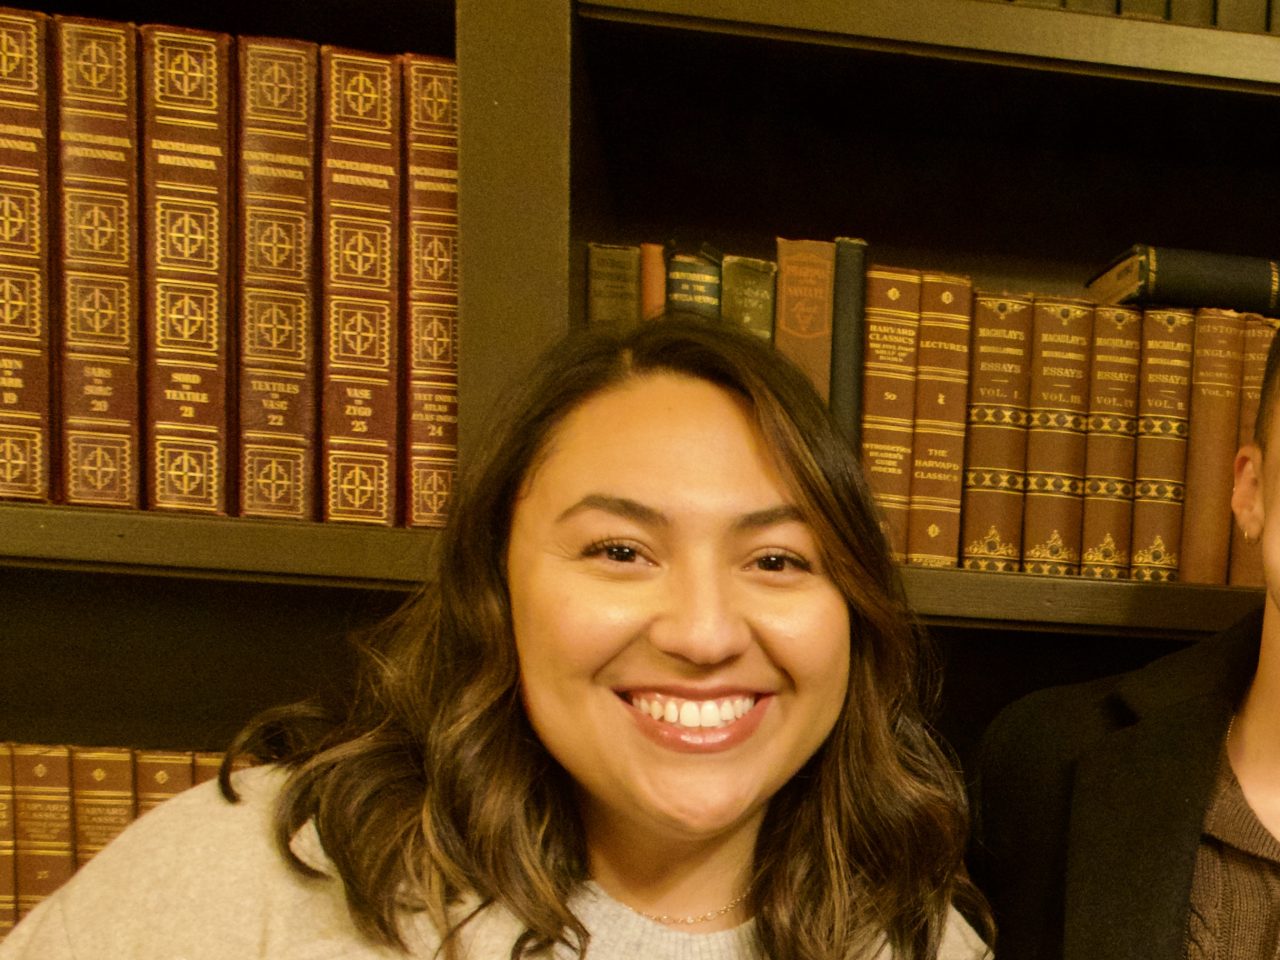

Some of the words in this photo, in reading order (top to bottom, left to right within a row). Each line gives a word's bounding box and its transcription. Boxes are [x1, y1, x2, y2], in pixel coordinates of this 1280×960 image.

[869, 324, 916, 336] HARVARD
[868, 333, 914, 344] CLASSICS
[920, 340, 968, 352] LECTURES
[980, 361, 1021, 374] ESSAYS
[1043, 366, 1083, 379] ESSAYS
[1096, 370, 1136, 383] ESSAYS
[1148, 373, 1188, 386] ESSAYS
[251, 380, 300, 394] TEXTILES
[346, 388, 372, 400] VASE
[268, 415, 284, 427] 22
[428, 425, 443, 437] 24
[914, 459, 959, 471] HARVARD
[914, 471, 958, 482] CLASSICS
